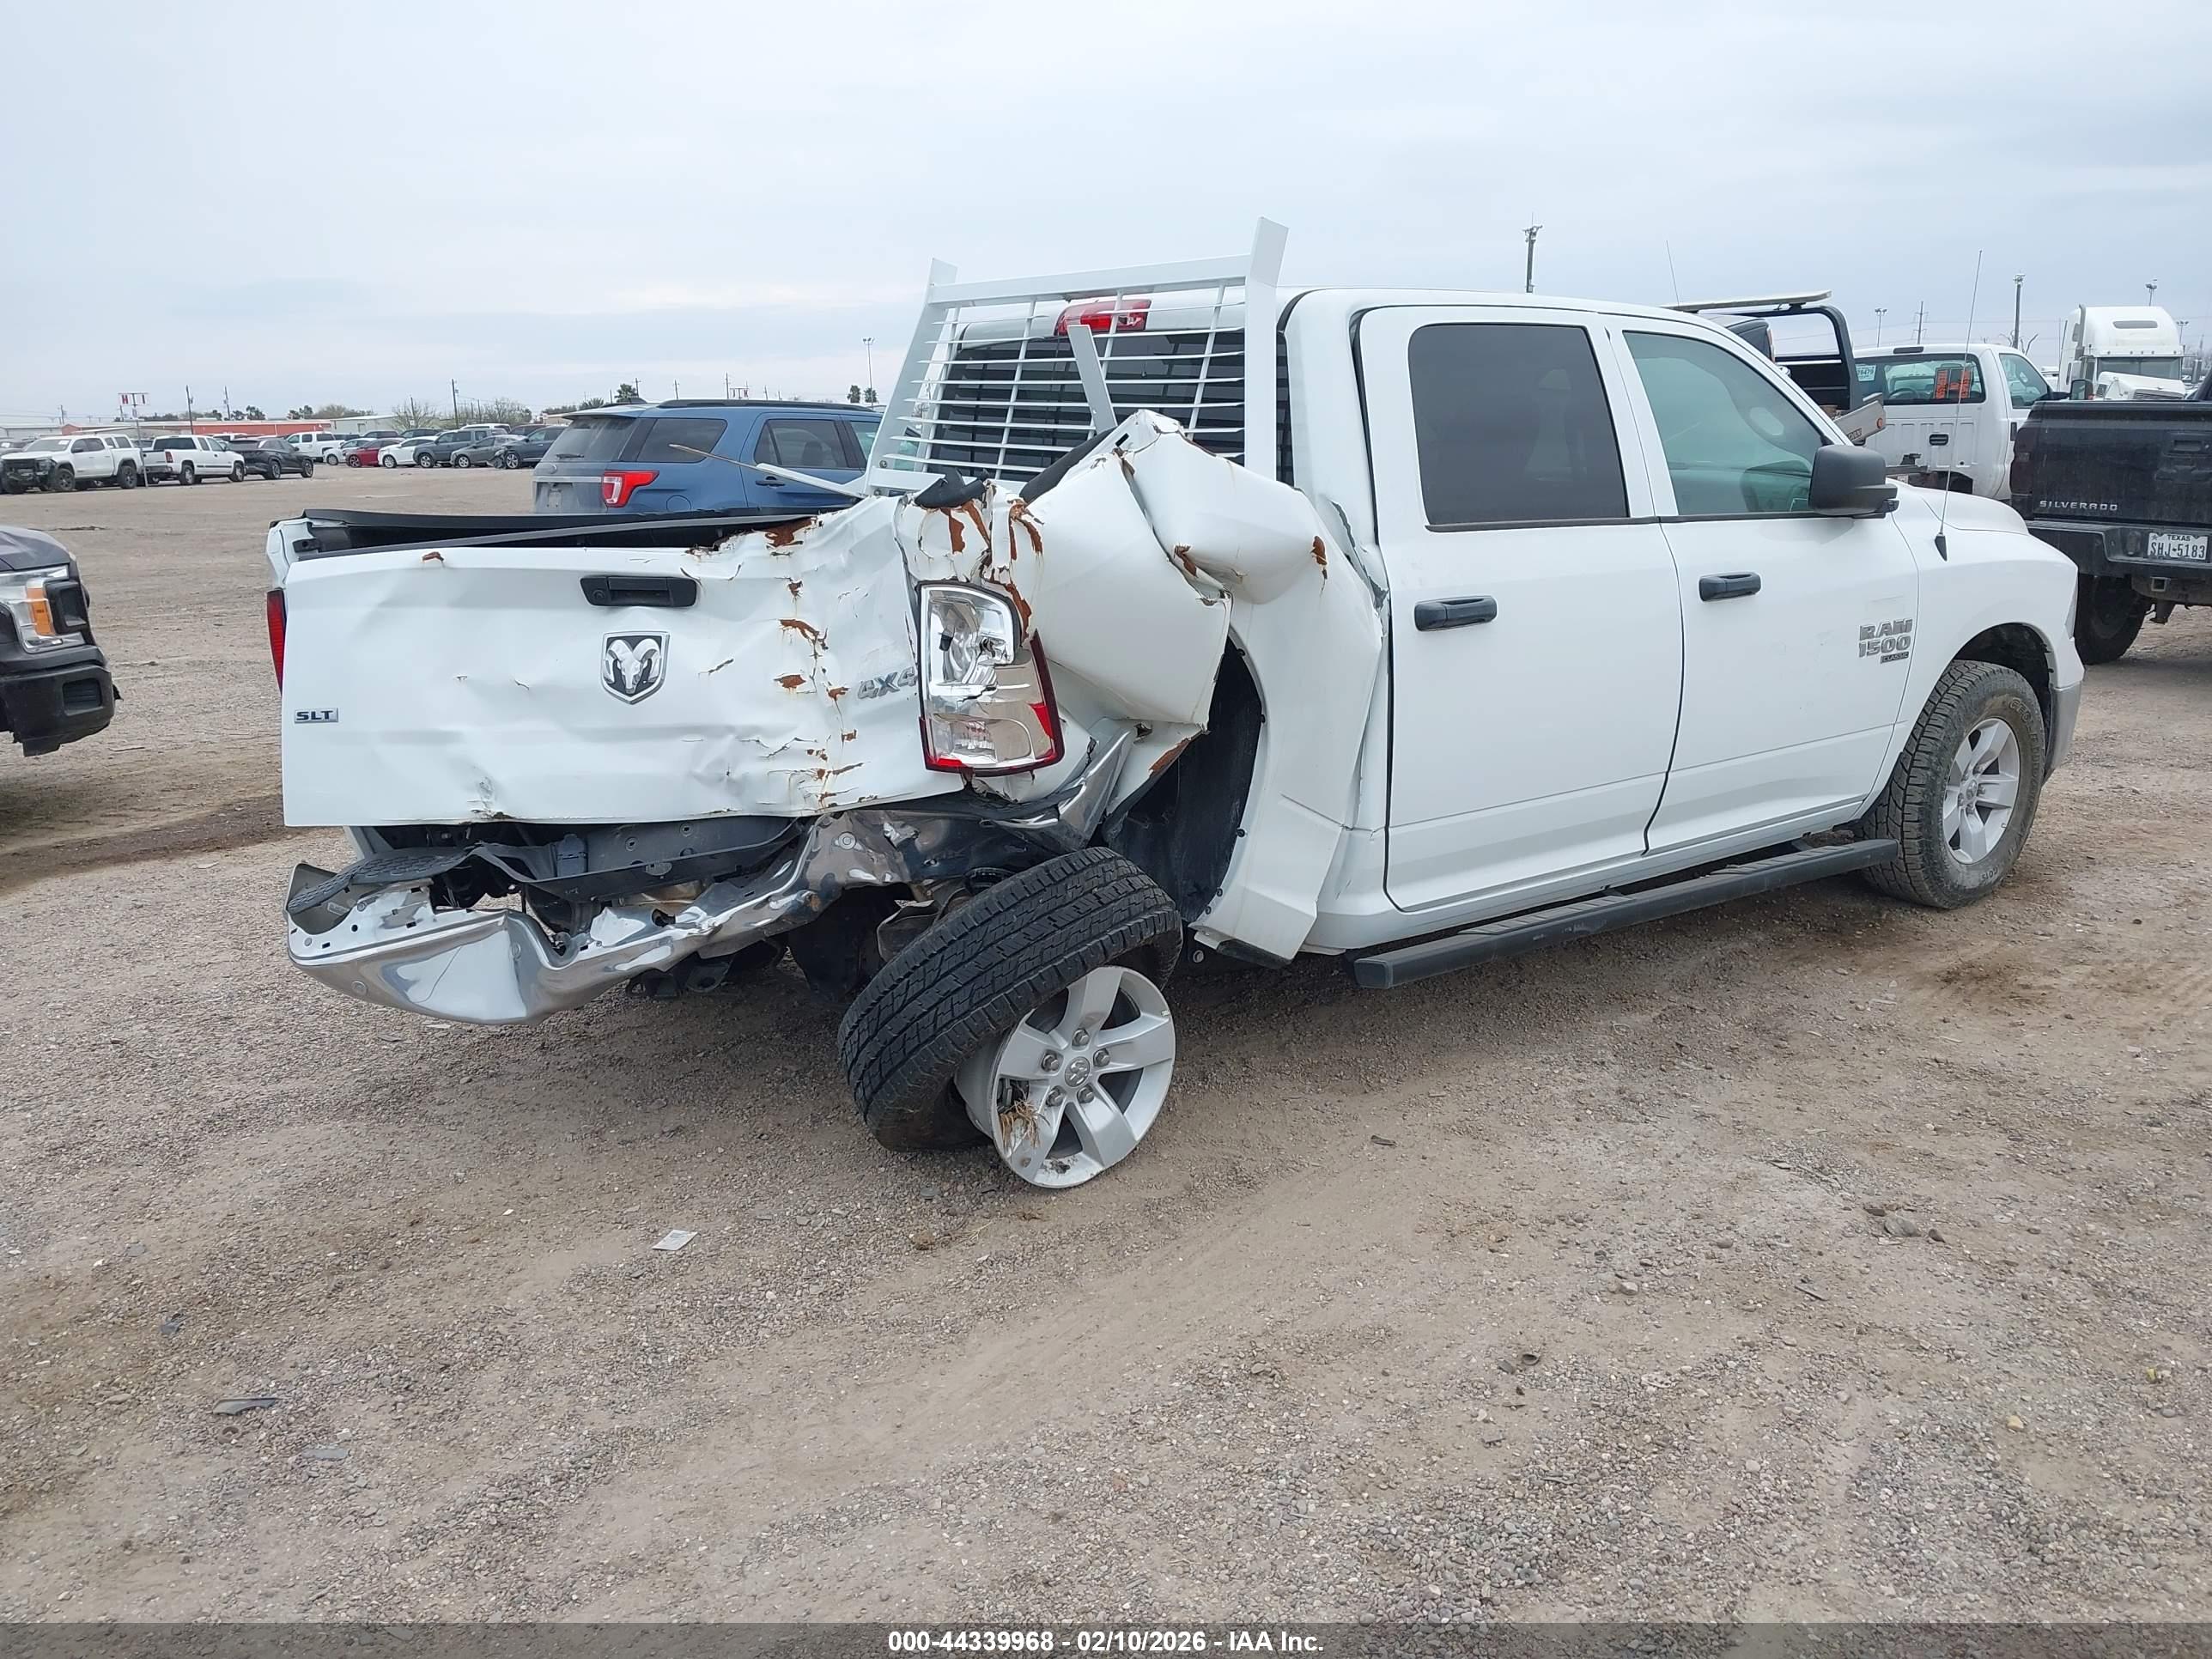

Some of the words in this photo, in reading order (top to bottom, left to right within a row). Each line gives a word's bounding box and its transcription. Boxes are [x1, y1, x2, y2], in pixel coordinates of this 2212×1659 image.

[2039, 500, 2118, 512] SILVERADO
[1859, 618, 1913, 641] RAM
[1858, 635, 1911, 659] 1500
[1882, 652, 1909, 662] CLASSIC
[295, 710, 334, 721] SLT
